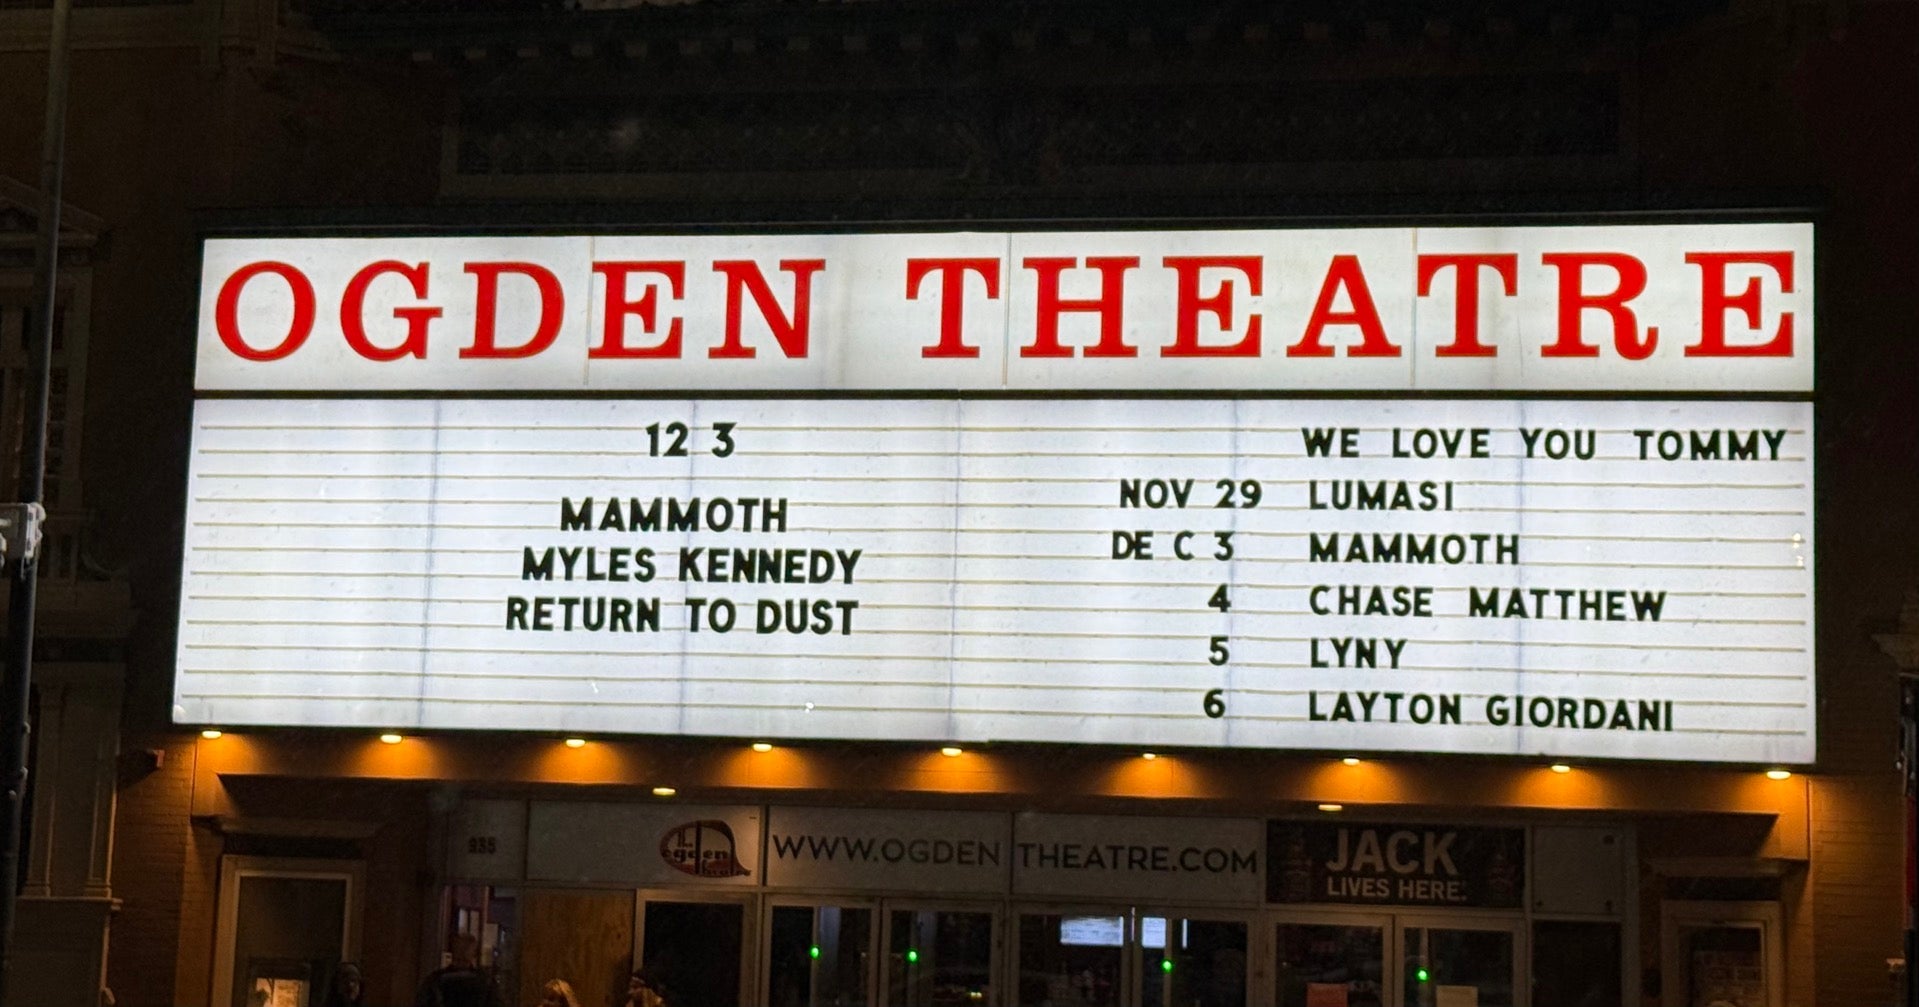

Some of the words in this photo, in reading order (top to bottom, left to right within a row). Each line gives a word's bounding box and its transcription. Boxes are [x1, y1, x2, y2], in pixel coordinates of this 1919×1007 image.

[214, 259, 826, 363] OGDEN
[905, 250, 1795, 362] THEATRE
[645, 421, 690, 458] 12
[710, 421, 737, 459] 3
[1300, 426, 1361, 459] WE
[1391, 427, 1491, 460] LOVE
[1518, 427, 1597, 461] YOU
[1632, 429, 1788, 462] TOMMY
[1119, 478, 1195, 510] NOV
[1213, 479, 1263, 510] 29
[1308, 480, 1454, 512] LUMASI
[559, 496, 788, 533] MAMMOTH
[1213, 530, 1236, 563] 3
[1308, 532, 1520, 566] MAMMOTH
[521, 545, 657, 583] MYLES
[678, 547, 864, 585] KENNEDY
[505, 596, 661, 633] RETURN
[683, 597, 737, 634] TO
[755, 598, 860, 636] DUST
[1206, 584, 1232, 614] 4
[1308, 585, 1434, 618] CHASE
[1468, 587, 1667, 622] MATTHEW
[1208, 635, 1230, 667] 5
[1308, 637, 1408, 669] LYNY
[1202, 687, 1227, 719] 6
[1308, 690, 1462, 726] LAYTON
[1484, 693, 1674, 733] GIORDANI
[1325, 828, 1460, 876] JACK
[1326, 876, 1391, 898] LIVES
